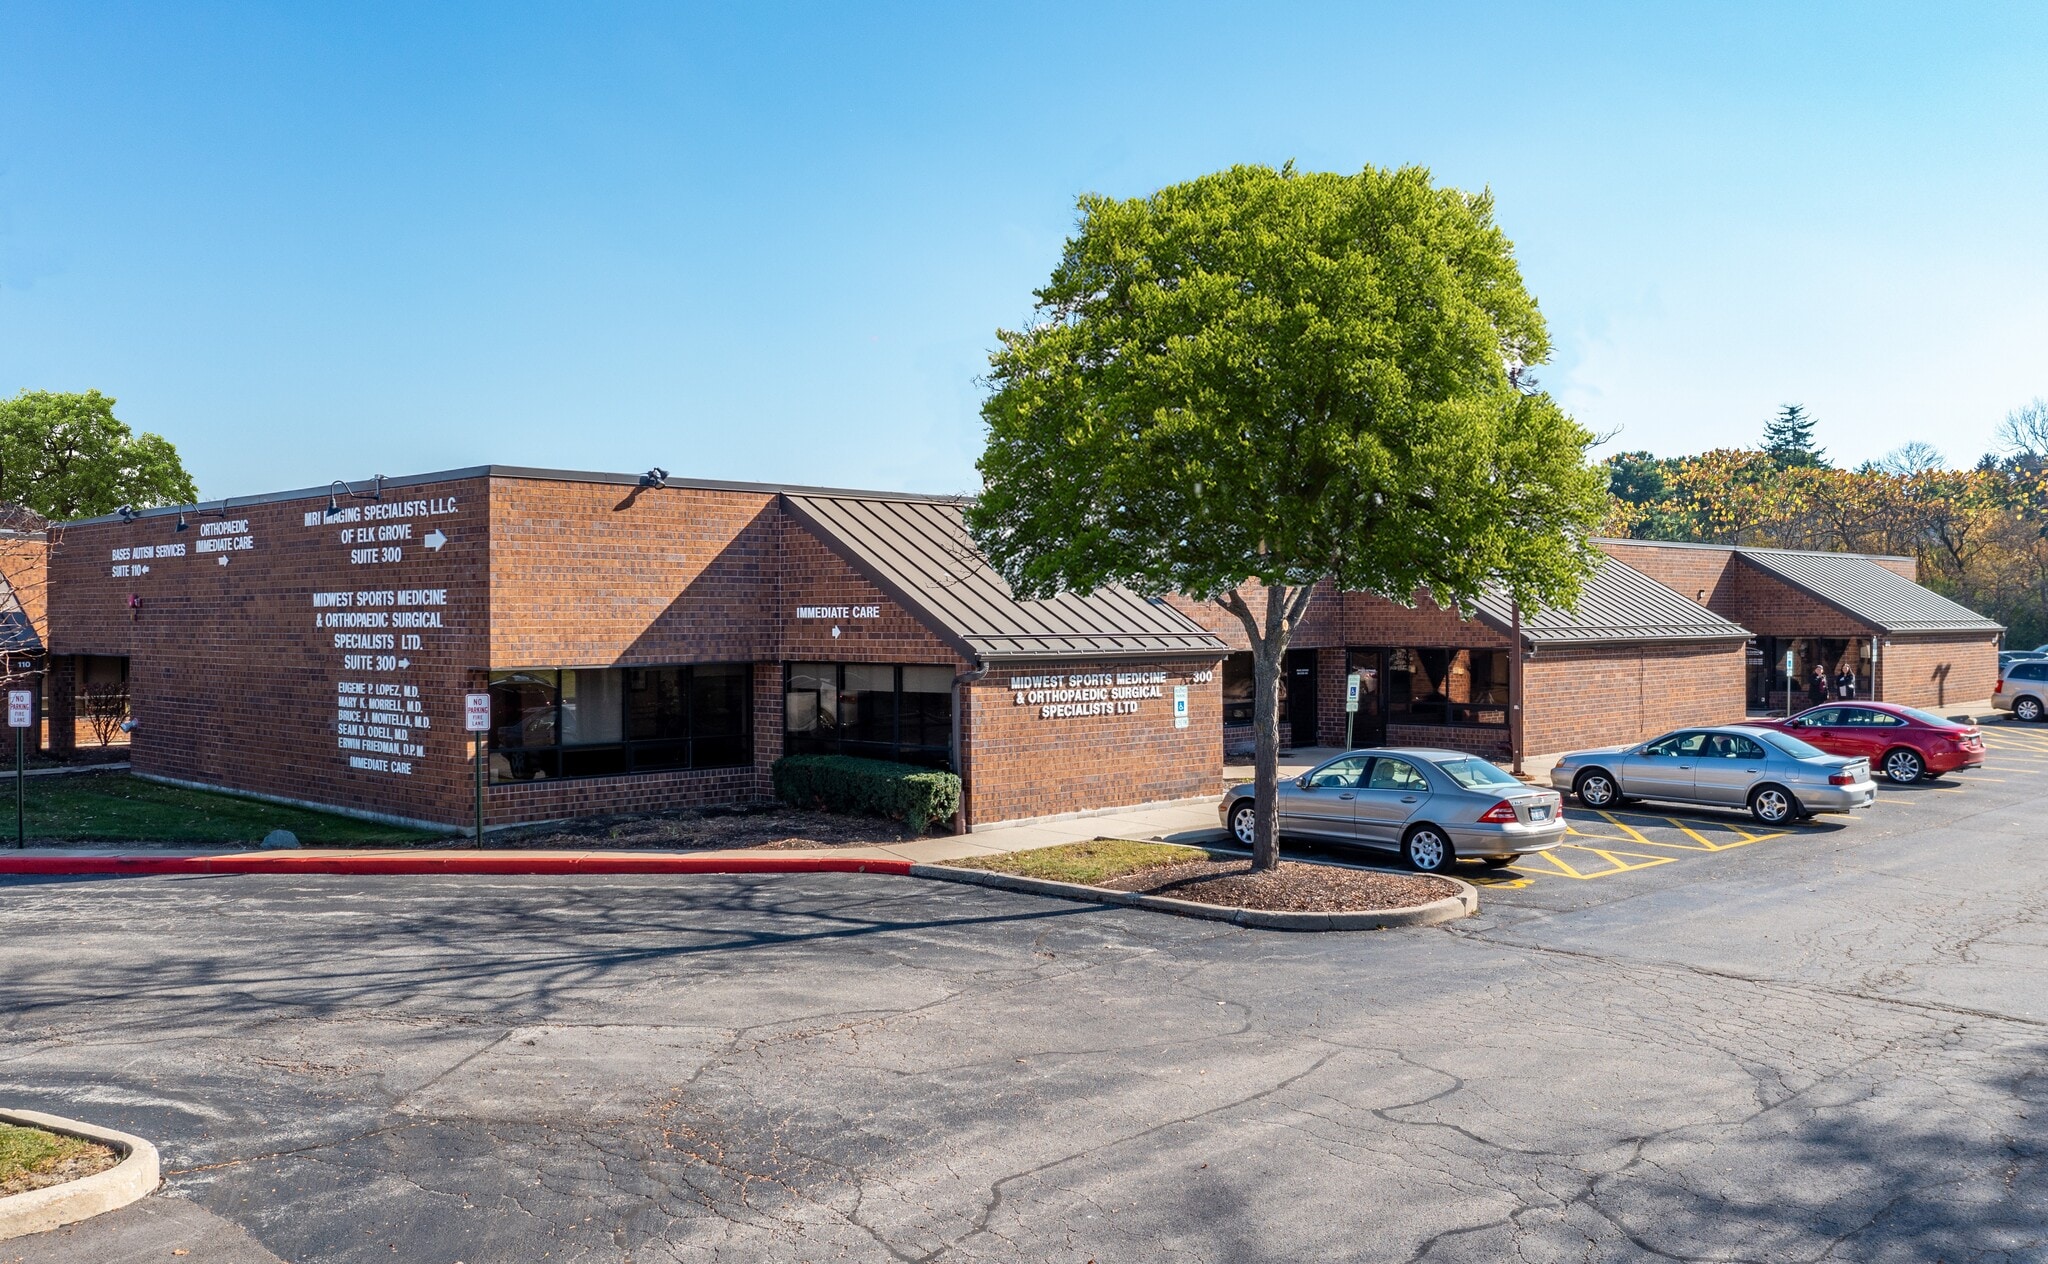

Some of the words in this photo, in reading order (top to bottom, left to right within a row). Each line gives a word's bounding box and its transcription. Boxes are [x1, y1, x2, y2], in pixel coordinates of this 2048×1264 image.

[305, 512, 320, 526] MRI
[364, 500, 429, 520] SPECIALISTS,
[431, 497, 458, 514] L.L.C.
[201, 520, 248, 536] ORTHOPAEDIC
[341, 529, 354, 544] OF
[358, 527, 375, 542] ELK
[378, 524, 411, 540] GROVE
[112, 548, 130, 561] BASES
[132, 546, 154, 559] AUTISM
[156, 544, 185, 557] SERVICES
[196, 538, 232, 553] IMMEDIATE
[234, 536, 253, 550] CARE
[351, 548, 378, 564] SUITE
[382, 547, 401, 562] 300
[112, 565, 129, 577] SUITE
[131, 564, 141, 576] 110
[314, 592, 353, 607] MIDWEST
[357, 591, 394, 606] SPORTS
[398, 590, 446, 605] MEDICINE
[316, 613, 322, 627] &
[326, 612, 388, 627] ORTHOPAEDIC
[392, 612, 443, 628] SURGICAL
[797, 607, 849, 618] IMMEDIATE
[853, 606, 880, 618] CARE
[335, 634, 394, 649] SPECIALISTS
[402, 635, 423, 650] LTD.
[345, 655, 372, 670] SUITE
[376, 656, 396, 670] 300
[1011, 676, 1064, 689] MIDWEST
[1069, 674, 1112, 686] SPORTS
[1117, 672, 1166, 684] MEDICINE
[1193, 671, 1212, 682] 300
[339, 682, 365, 694] EUGENE
[376, 684, 401, 697] LOPEZ,
[1017, 692, 1024, 704] &
[1028, 688, 1108, 703] ORTHOPAEDIC
[1112, 686, 1162, 698] SURGICAL
[339, 696, 357, 707] MARY
[360, 698, 367, 708] K.
[369, 699, 404, 713] MORRELL,
[1042, 703, 1113, 717] SPECIALISTS
[1118, 701, 1137, 713] LTD
[339, 710, 361, 722] BRUCE
[364, 712, 369, 723] J.
[372, 712, 412, 728] MONTELLA,
[338, 724, 357, 736] SEAN
[359, 725, 366, 736] D.
[368, 726, 393, 741] ODELL,
[339, 737, 360, 750] ERWIN
[362, 740, 400, 756] FRIEDMAN,
[403, 744, 425, 757] D.P.M.
[350, 756, 388, 772] IMMEDIATE
[391, 762, 411, 774] CARE
